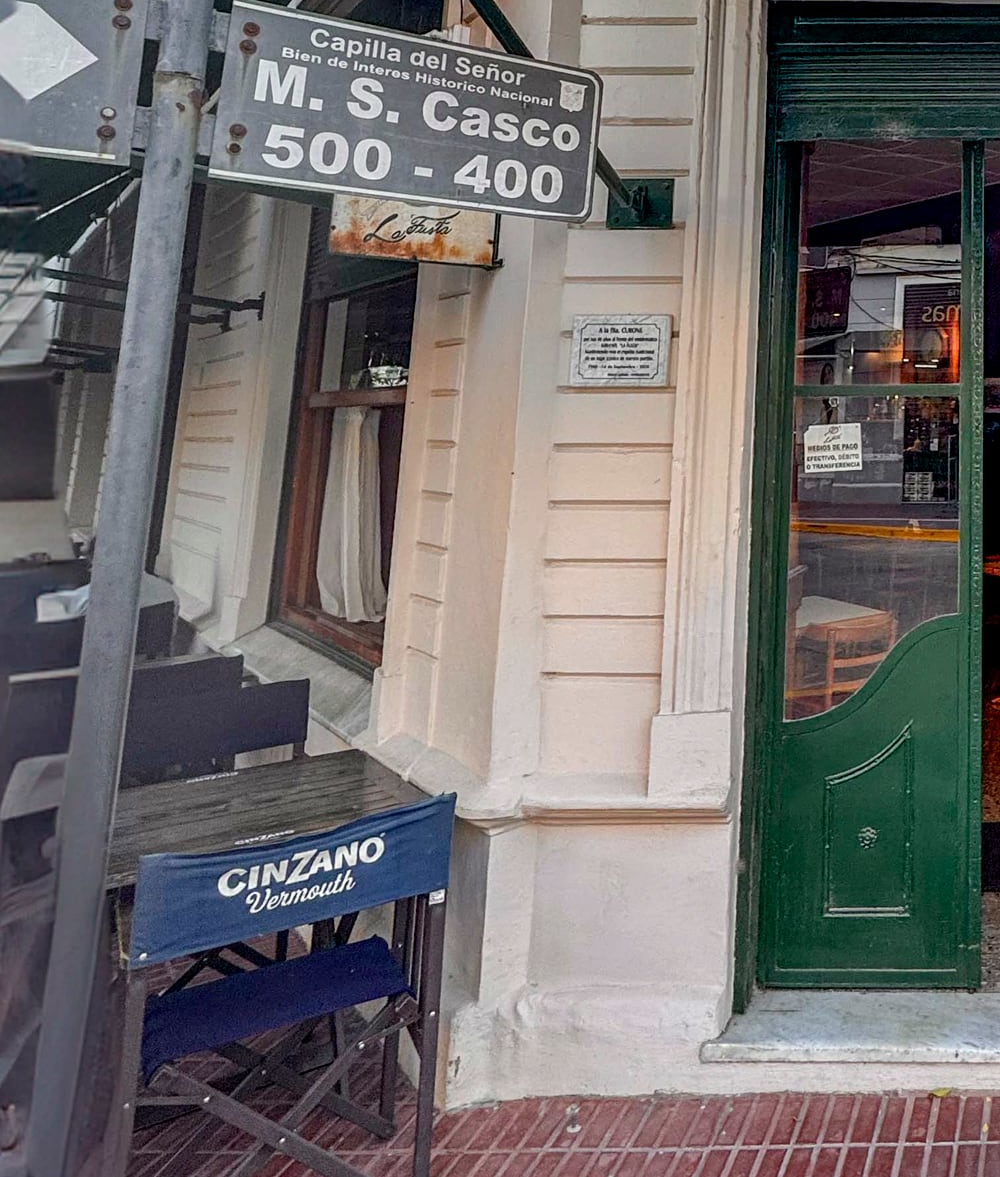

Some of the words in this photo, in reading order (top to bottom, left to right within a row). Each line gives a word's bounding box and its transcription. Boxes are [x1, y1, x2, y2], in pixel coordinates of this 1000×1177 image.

[281, 47, 321, 64] Bien
[327, 54, 348, 69] de
[354, 61, 410, 80] Interes
[415, 73, 485, 94] Historico
[490, 86, 554, 107] Nacional
[310, 29, 401, 63] Capilla
[410, 47, 447, 71] del
[455, 57, 526, 86] Señor
[253, 59, 324, 111] M.
[347, 77, 400, 123] S.
[422, 91, 580, 152] Casco
[261, 124, 392, 180] 500
[414, 166, 433, 177] -
[453, 154, 563, 203] 400
[363, 213, 406, 243] La
[406, 210, 461, 235] Fusta
[808, 444, 831, 452] MEDIOS
[217, 834, 385, 897] CINZANO
[245, 869, 356, 914] Vermouth
